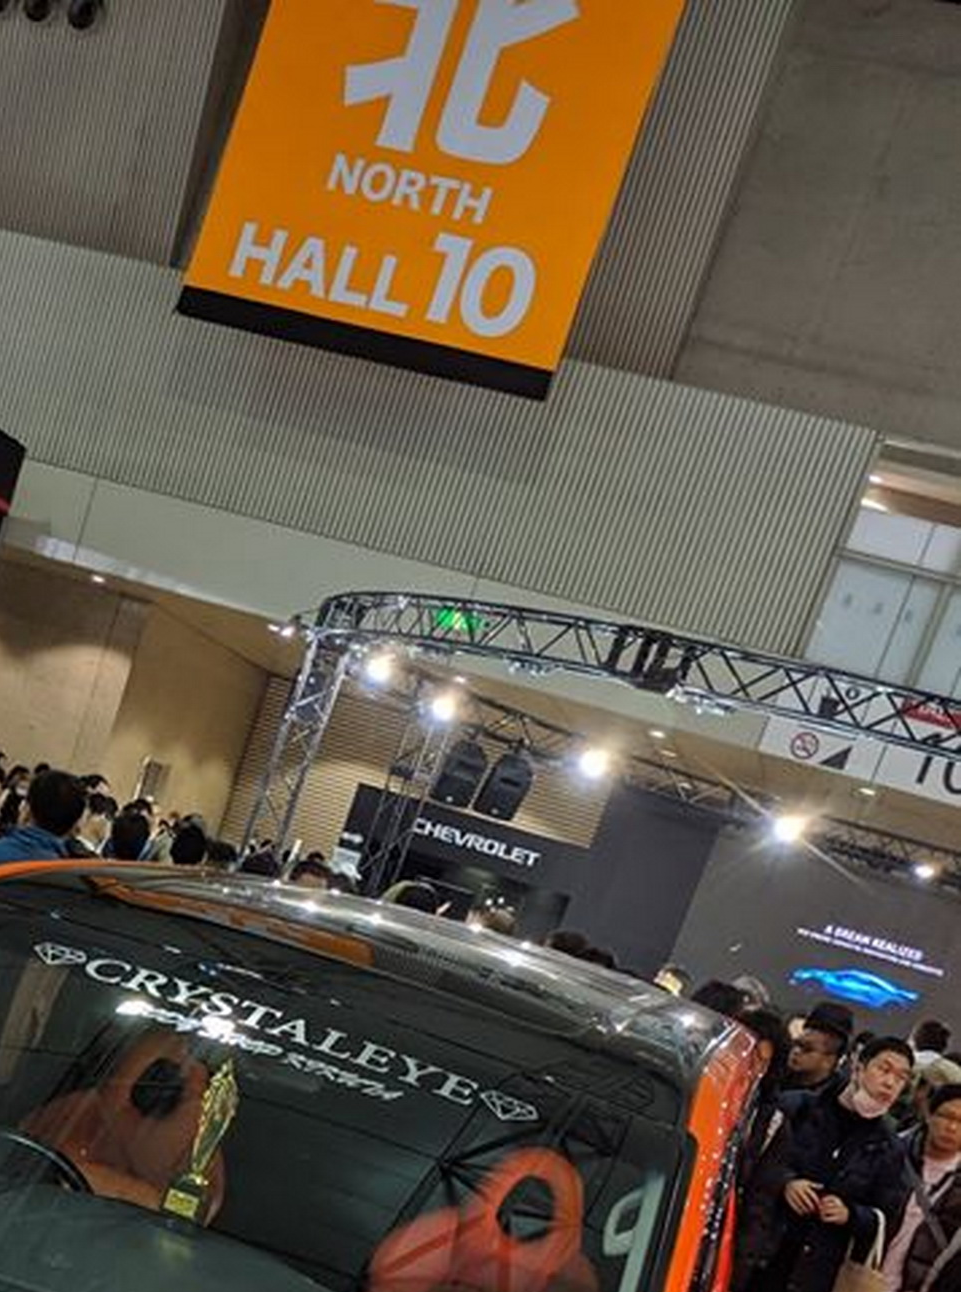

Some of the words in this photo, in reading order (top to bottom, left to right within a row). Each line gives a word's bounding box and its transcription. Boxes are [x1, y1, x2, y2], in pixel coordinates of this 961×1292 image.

[343, 0, 580, 165] 北
[327, 153, 492, 223] NORTH
[229, 222, 410, 318] HALL
[425, 232, 536, 338] 10
[413, 817, 541, 867] CHEVROLET
[85, 958, 479, 1106] CRYSTALEYE
